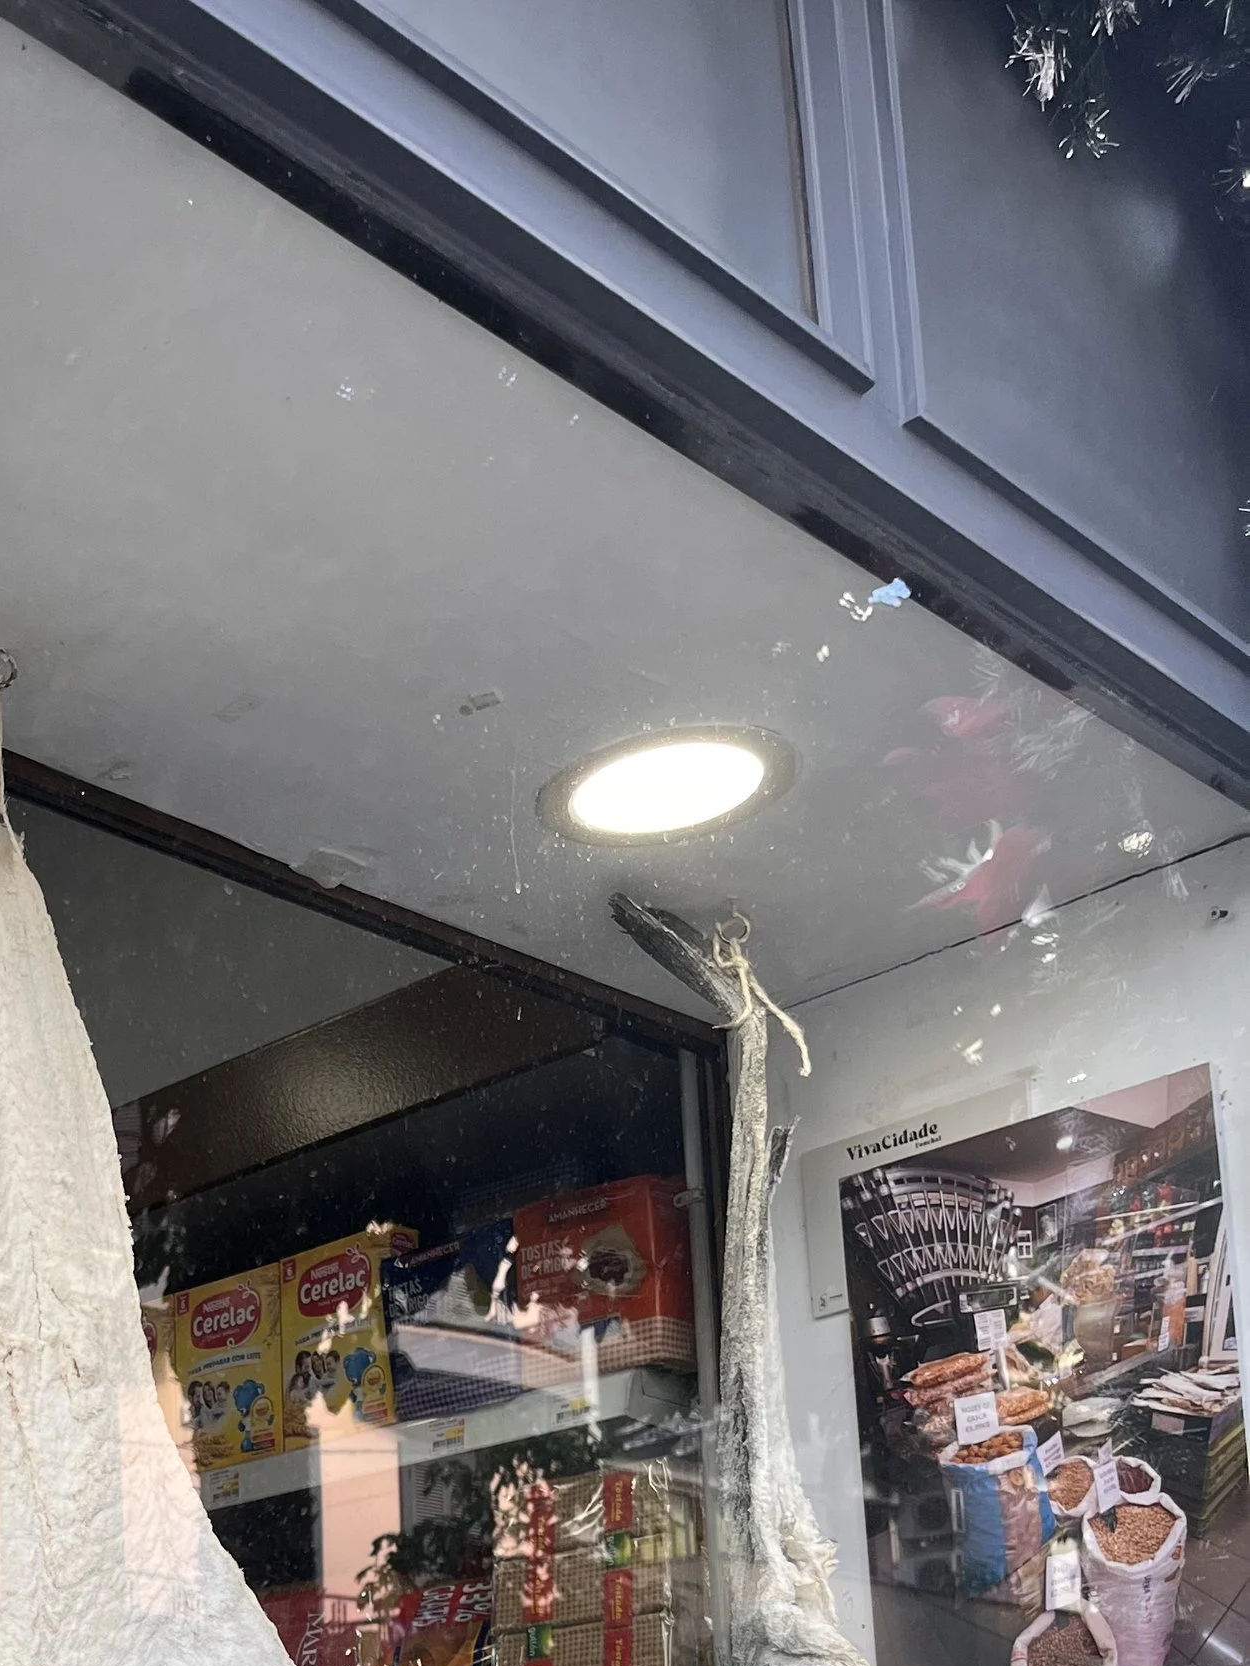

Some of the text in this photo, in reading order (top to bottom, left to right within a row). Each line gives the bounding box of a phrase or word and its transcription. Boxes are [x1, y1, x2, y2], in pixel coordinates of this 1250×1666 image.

[846, 1122, 938, 1160] VivaCidade
[549, 1199, 608, 1223] AMANHECER
[521, 1239, 566, 1259] TOSTAS
[300, 1270, 366, 1304] Cerelac
[192, 1304, 256, 1338] Cerelac
[613, 1480, 624, 1522] Tostada
[613, 1576, 624, 1619] Tostada
[528, 1625, 537, 1657] gullón
